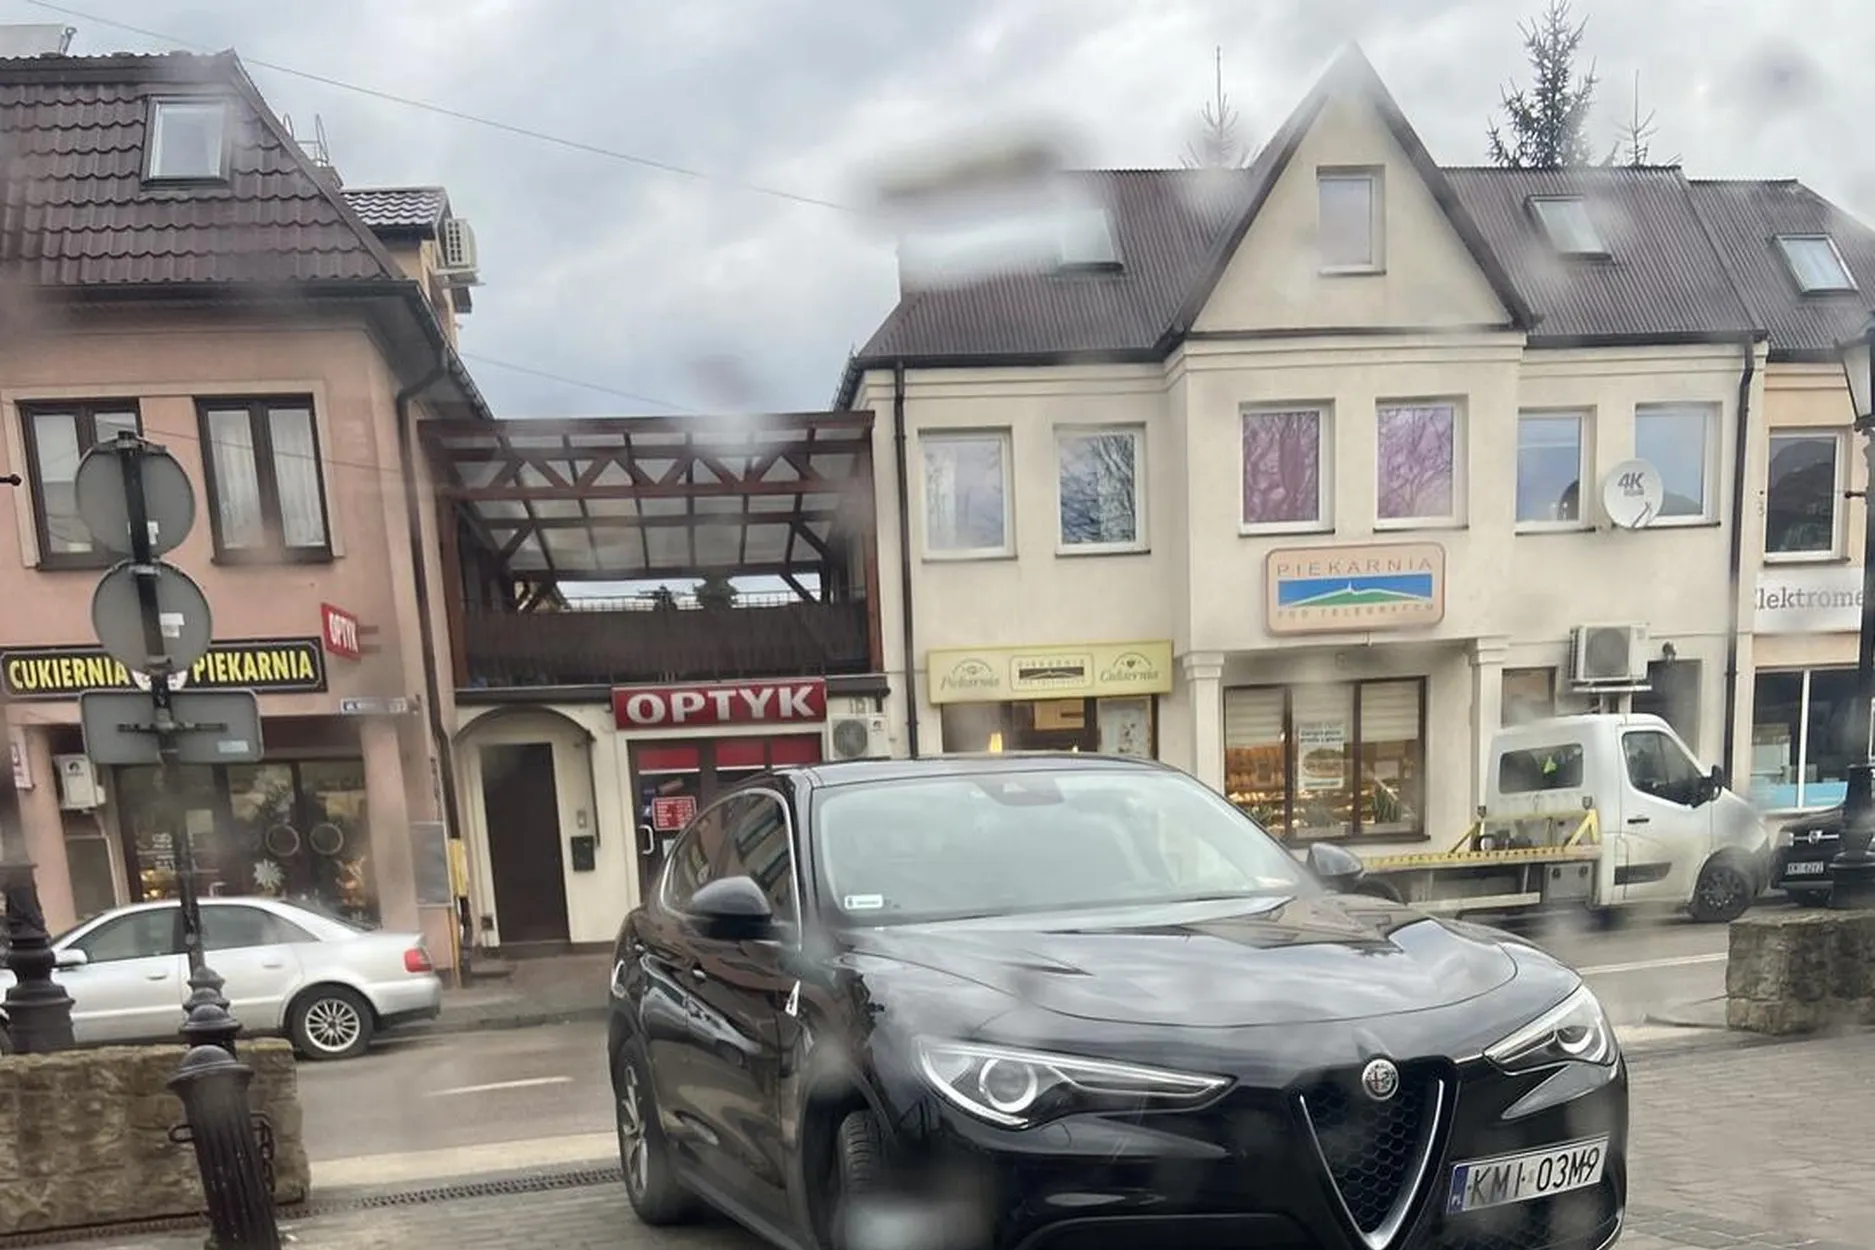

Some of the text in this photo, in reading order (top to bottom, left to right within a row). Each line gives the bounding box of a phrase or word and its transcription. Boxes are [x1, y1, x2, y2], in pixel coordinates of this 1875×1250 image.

[1617, 472, 1645, 489] 4K
[1277, 556, 1433, 577] PIEKARNIA
[1754, 586, 1863, 609] lektrome
[9, 650, 314, 690] CUKIERNIA PIEKARNIA
[626, 685, 815, 725] OPTYK
[1470, 1147, 1600, 1205] KMI 03M9
